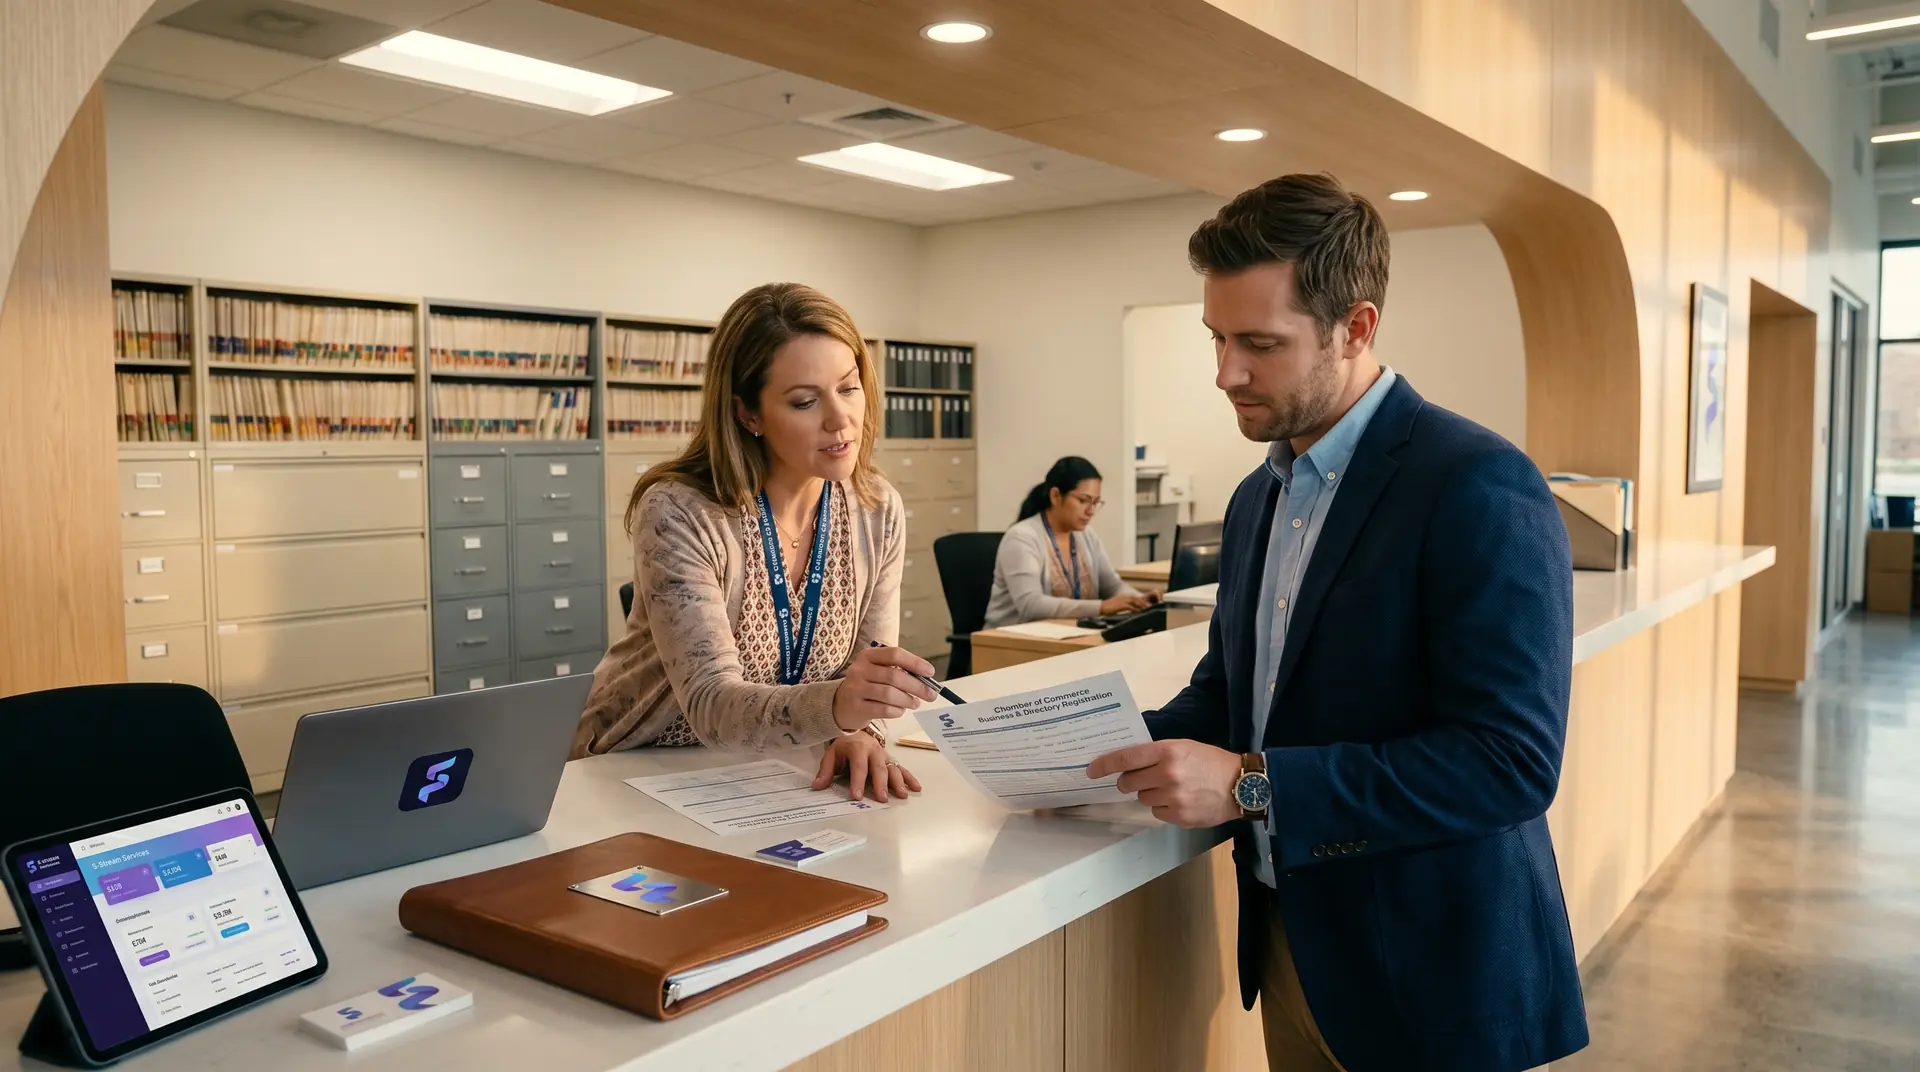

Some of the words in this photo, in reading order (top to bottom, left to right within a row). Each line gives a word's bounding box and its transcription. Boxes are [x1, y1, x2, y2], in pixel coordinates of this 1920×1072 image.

[977, 713, 1015, 723] Business
[1023, 703, 1061, 716] Directory
[1061, 691, 1114, 708] Registration
[1034, 698, 1043, 706] of
[1043, 688, 1090, 704] Commerce
[91, 857, 122, 870] S-Stream
[121, 849, 150, 862] Services
